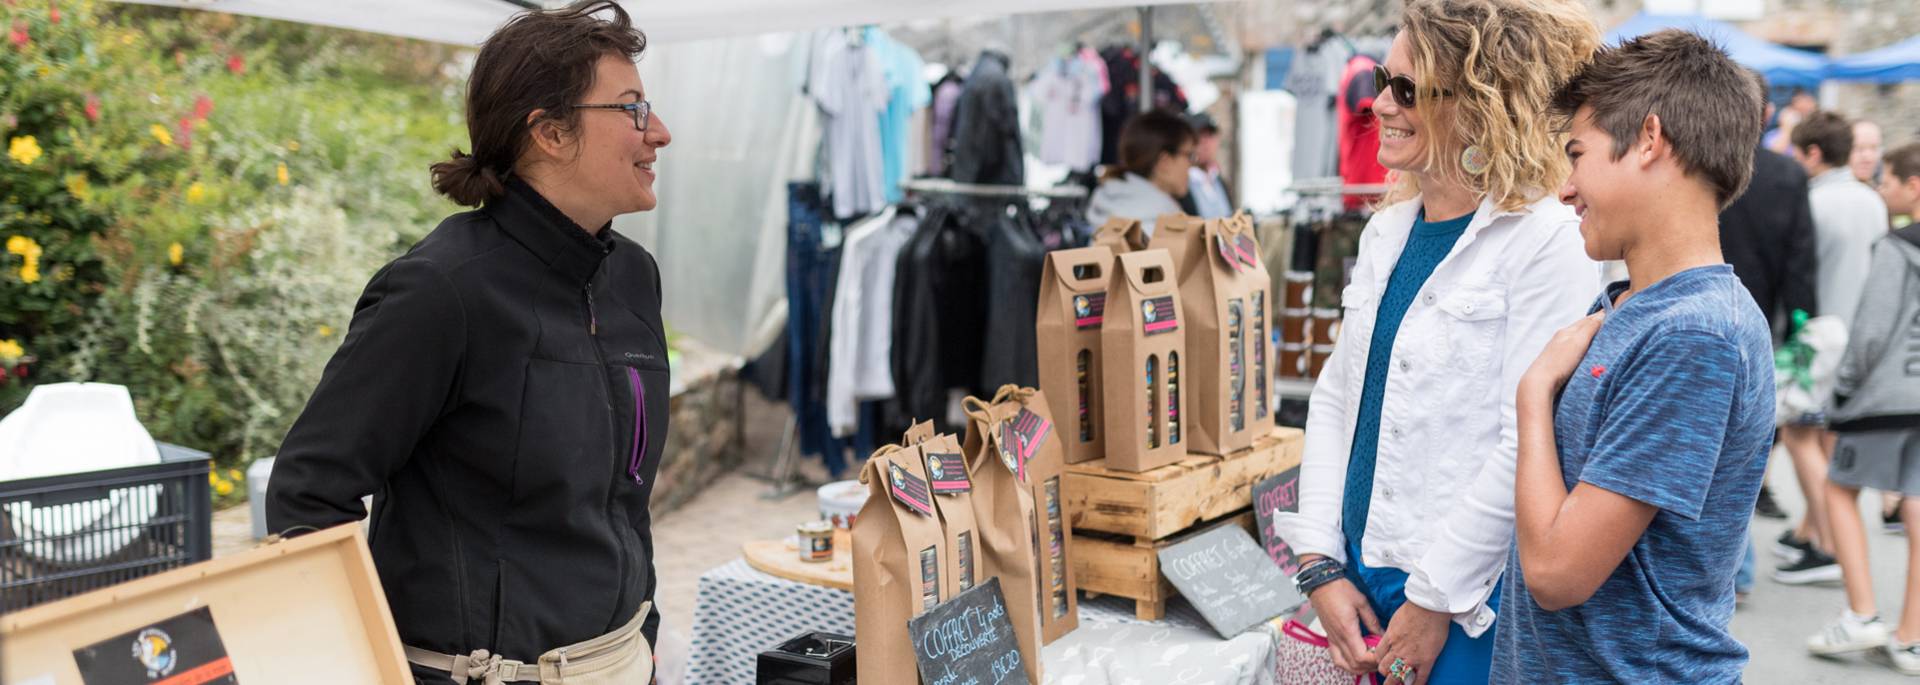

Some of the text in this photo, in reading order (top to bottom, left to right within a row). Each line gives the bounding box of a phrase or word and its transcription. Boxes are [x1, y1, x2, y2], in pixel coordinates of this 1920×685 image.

[1260, 478, 1297, 517] COFFRET
[1173, 544, 1223, 580] COFFRET
[924, 594, 1005, 659] COFFRET 4 pots
